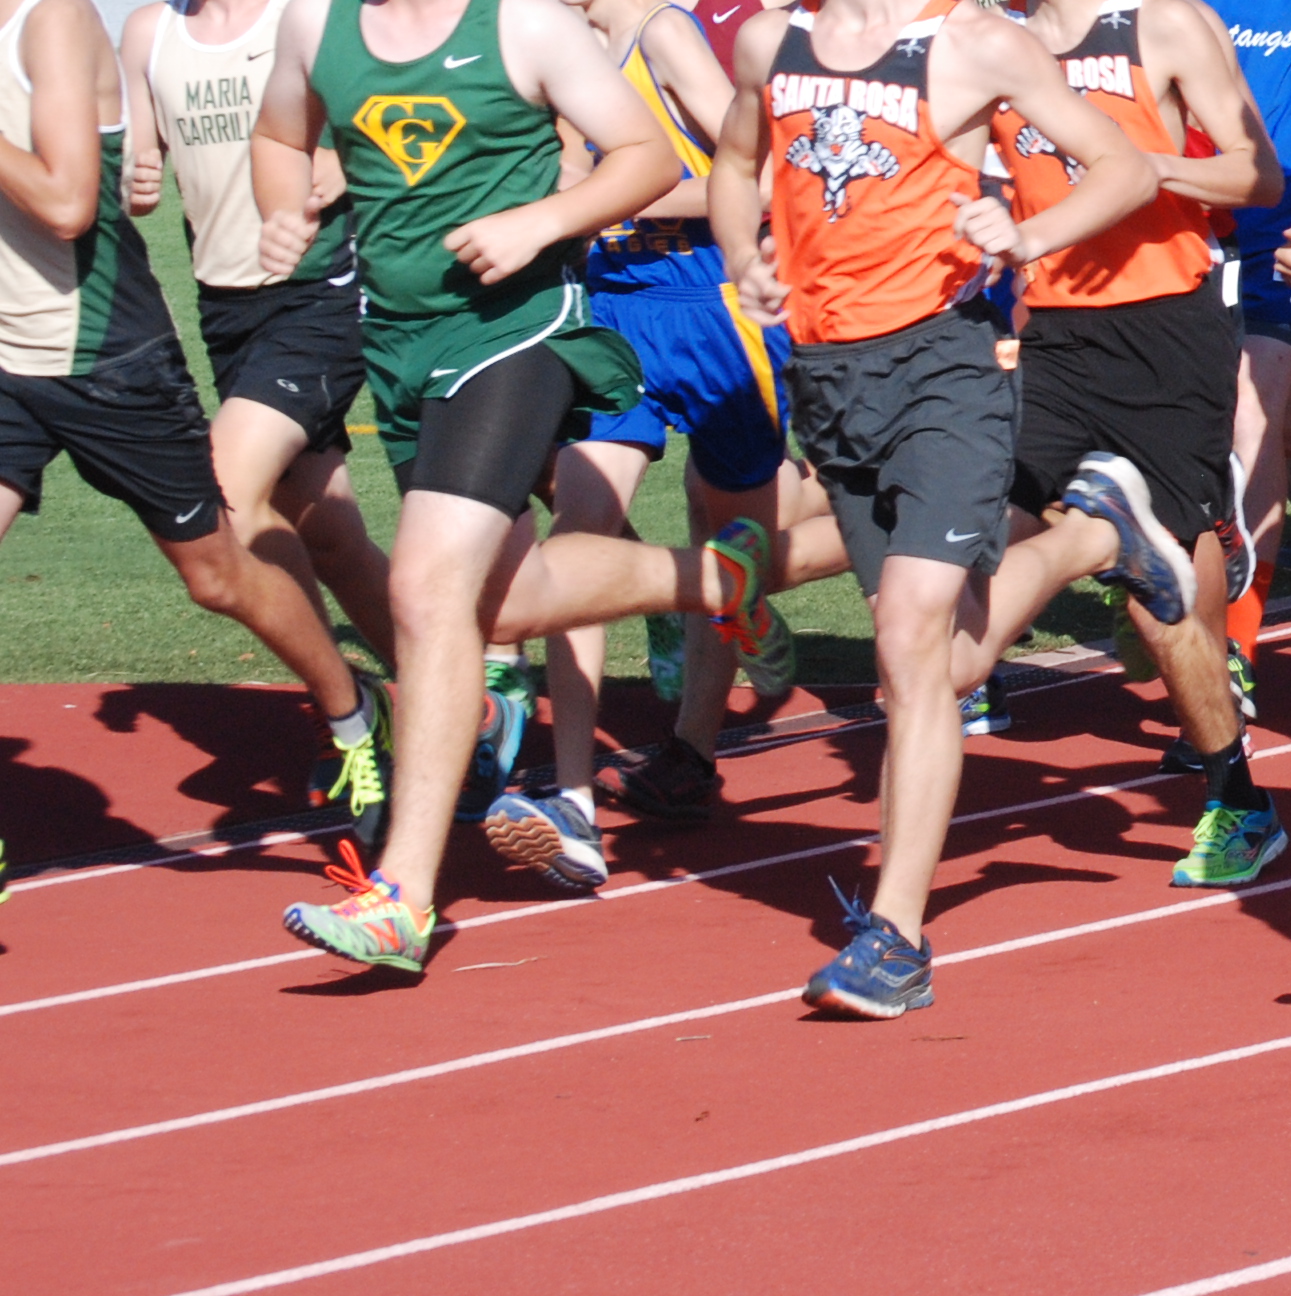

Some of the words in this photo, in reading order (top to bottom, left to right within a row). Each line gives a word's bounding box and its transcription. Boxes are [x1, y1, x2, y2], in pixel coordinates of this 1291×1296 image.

[185, 75, 253, 111] MARIA
[1066, 54, 1136, 100] ROSA
[771, 73, 846, 119] SANTA
[848, 78, 920, 136] ROSA
